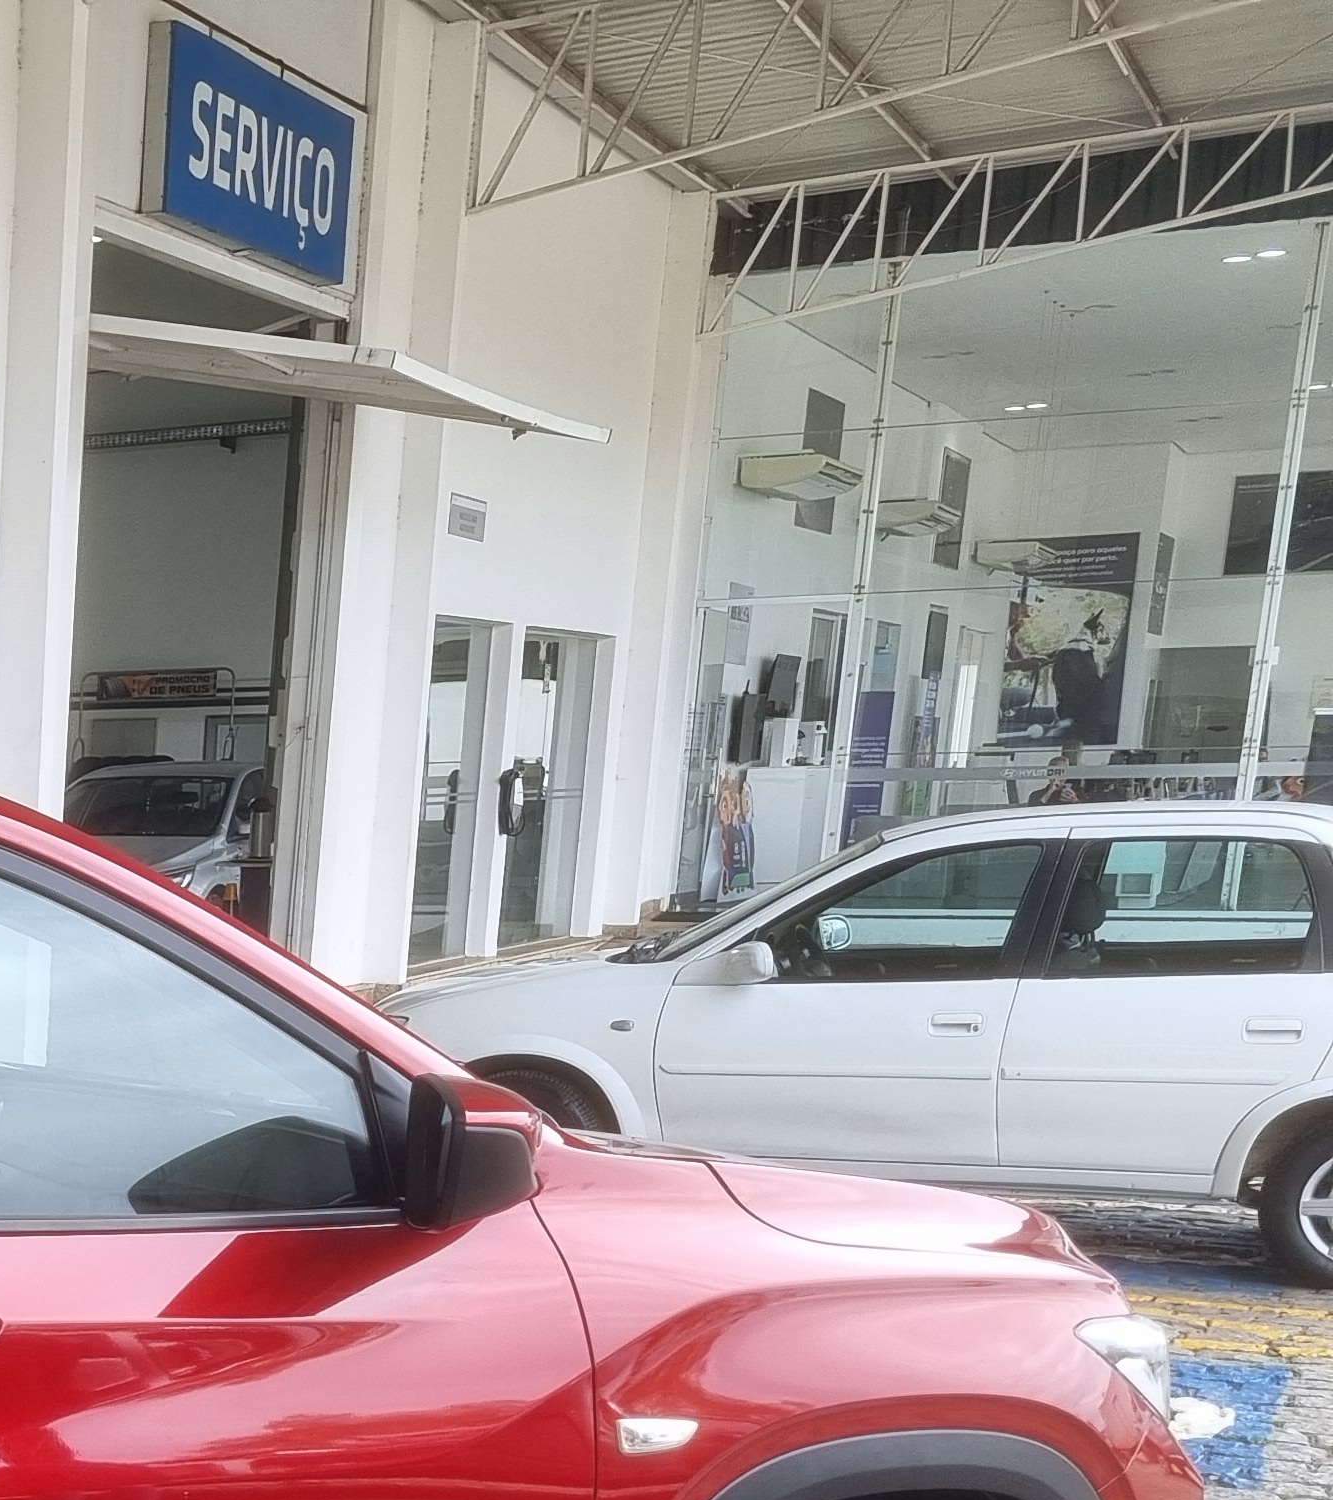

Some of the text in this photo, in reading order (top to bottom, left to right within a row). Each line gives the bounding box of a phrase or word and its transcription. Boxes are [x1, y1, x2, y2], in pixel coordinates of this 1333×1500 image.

[188, 80, 335, 250] SERVIÇO
[149, 684, 210, 695] DE PNEUS
